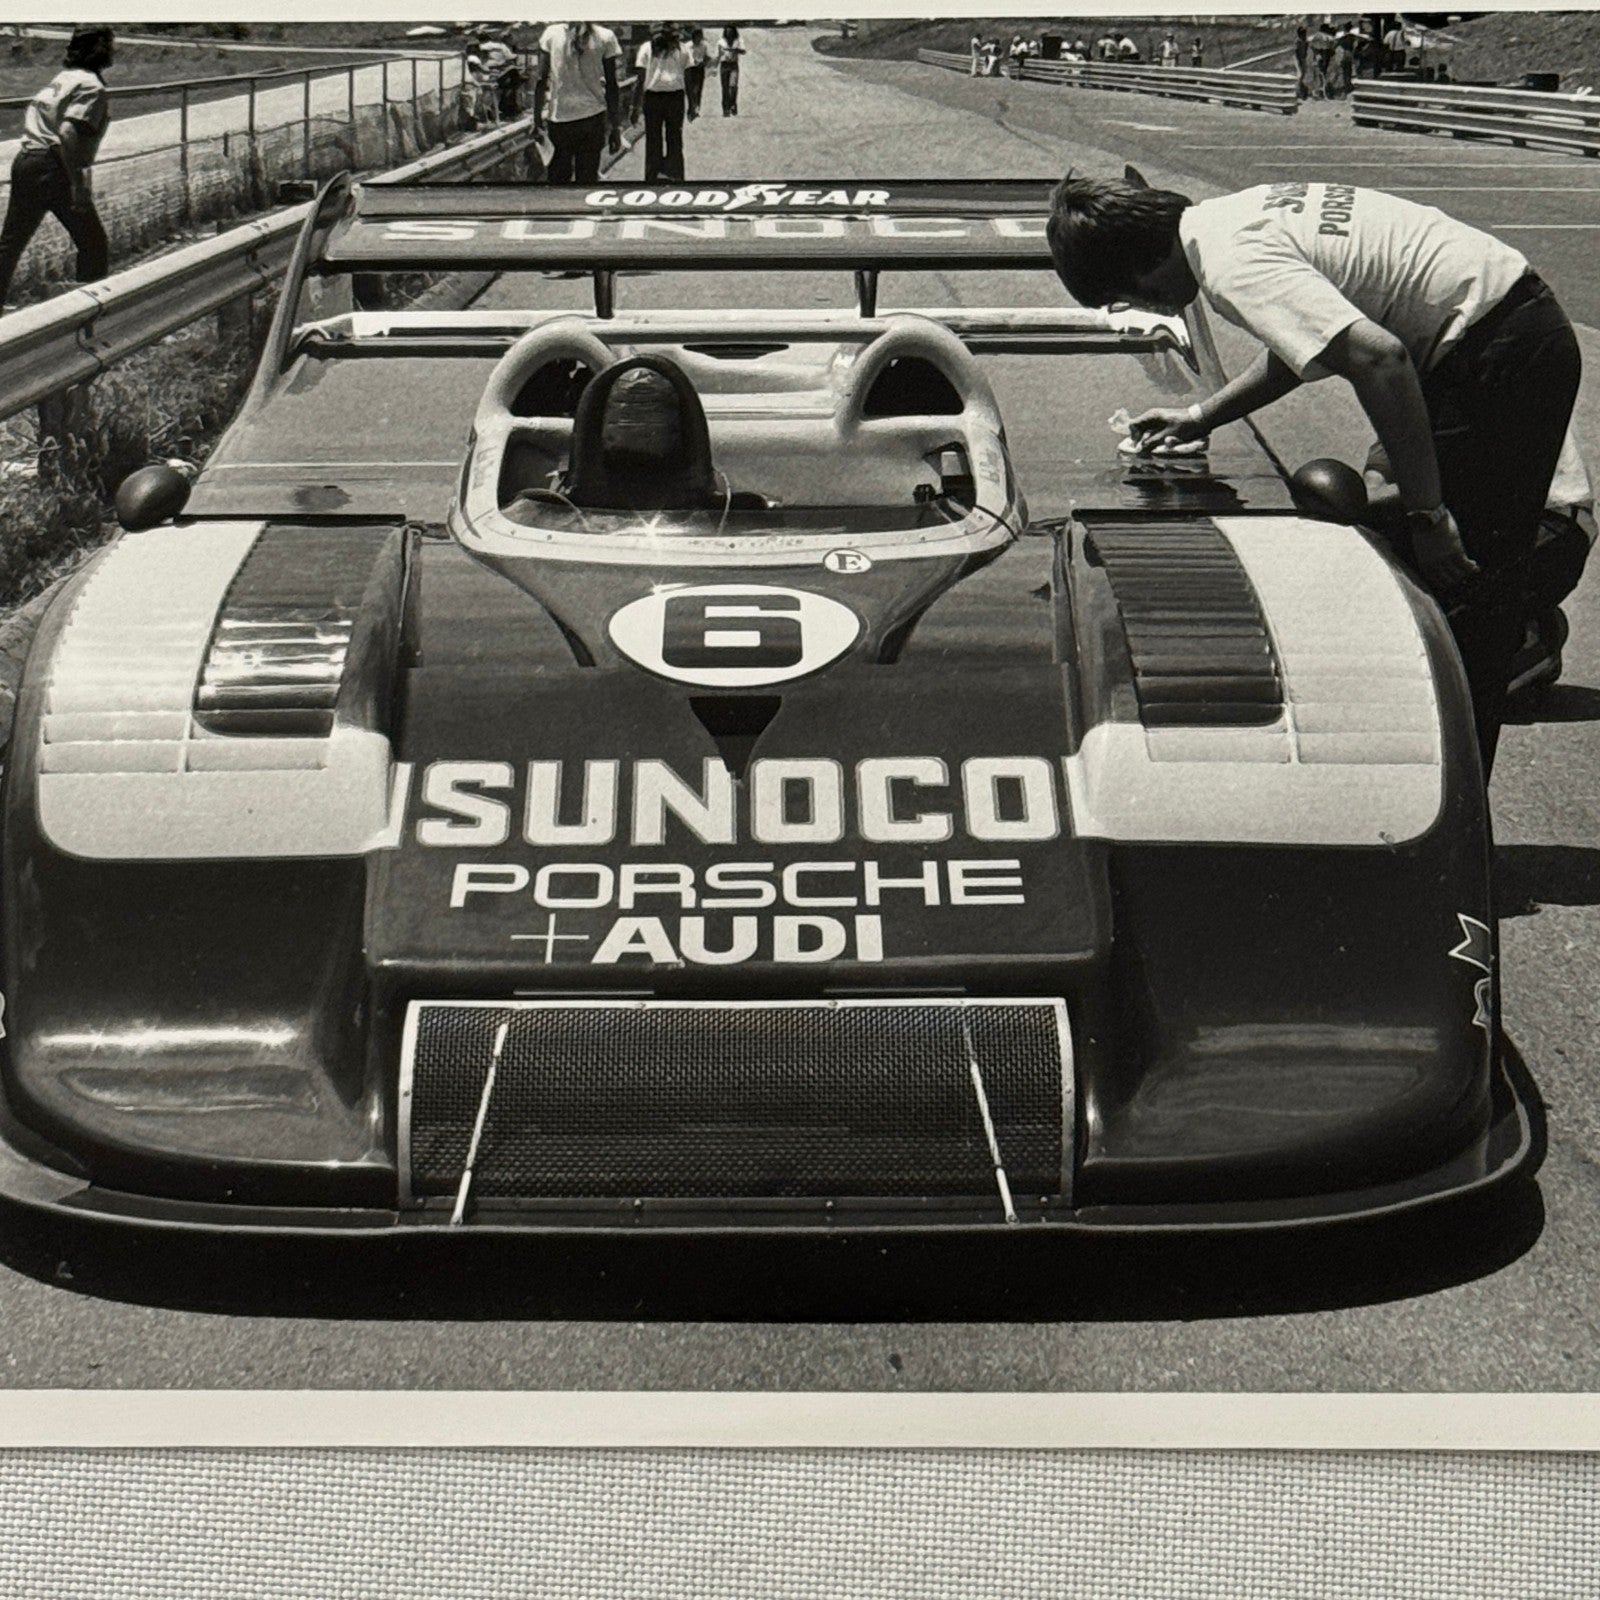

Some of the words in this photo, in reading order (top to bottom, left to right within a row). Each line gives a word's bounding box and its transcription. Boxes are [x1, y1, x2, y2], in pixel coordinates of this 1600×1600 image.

[585, 184, 890, 211] GOODYEAR
[834, 553, 861, 570] E
[662, 594, 803, 668] 6
[416, 756, 1060, 847] SUNOCO
[450, 859, 1025, 909] PORSCHE
